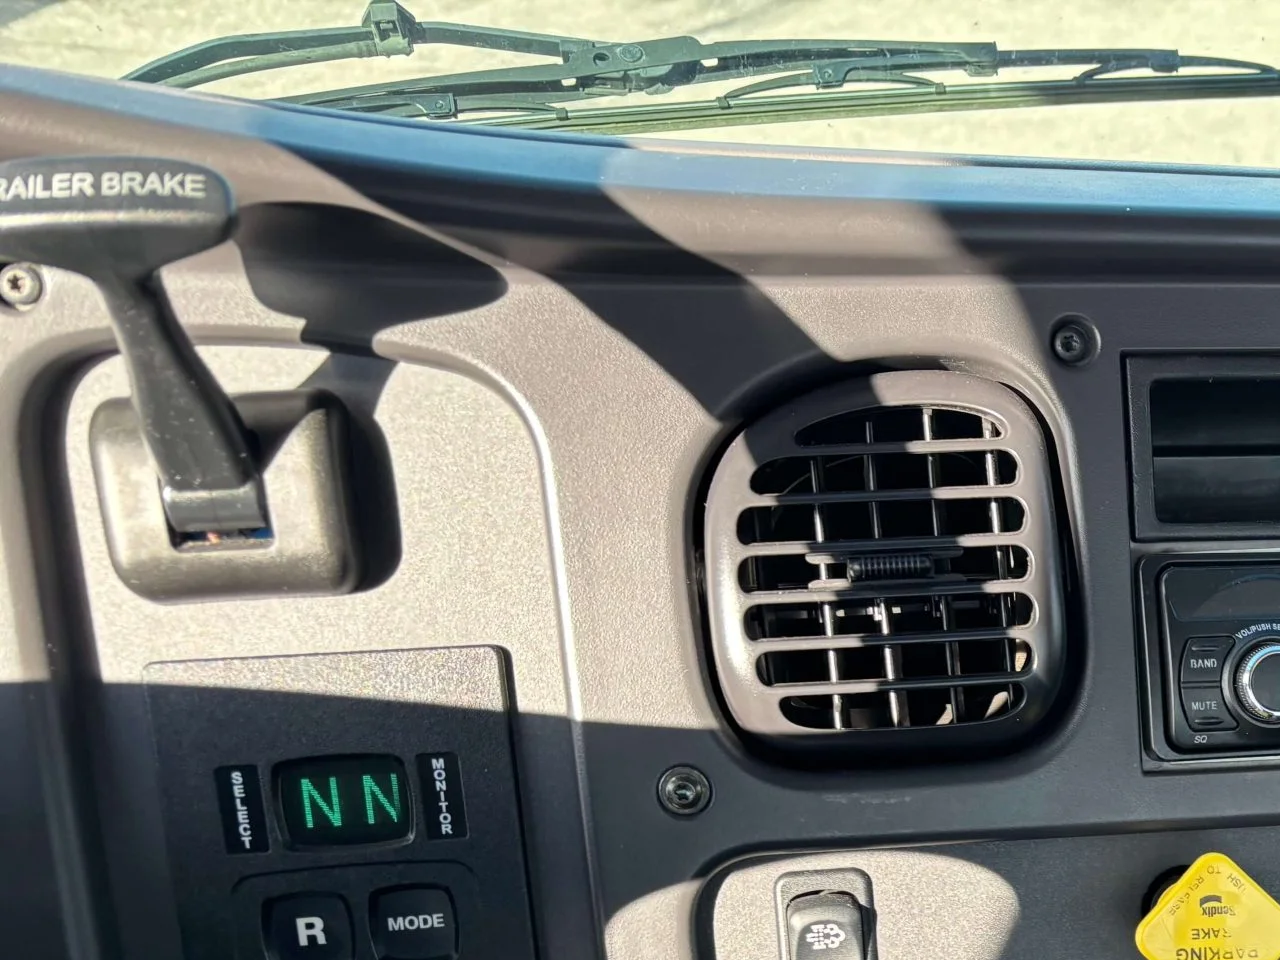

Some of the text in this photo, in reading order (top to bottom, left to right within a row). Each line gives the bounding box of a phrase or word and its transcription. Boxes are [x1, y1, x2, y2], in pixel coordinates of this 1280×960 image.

[100, 171, 207, 198] BRAKE
[1190, 658, 1218, 669] BAND
[1191, 700, 1218, 711] MUTE
[1194, 735, 1209, 745] SQ
[300, 773, 401, 828] N N
[431, 758, 454, 835] MONITOR
[231, 771, 253, 849] SELECT
[296, 916, 327, 946] R
[387, 913, 446, 932] MODE
[1191, 928, 1232, 941] RAKE
